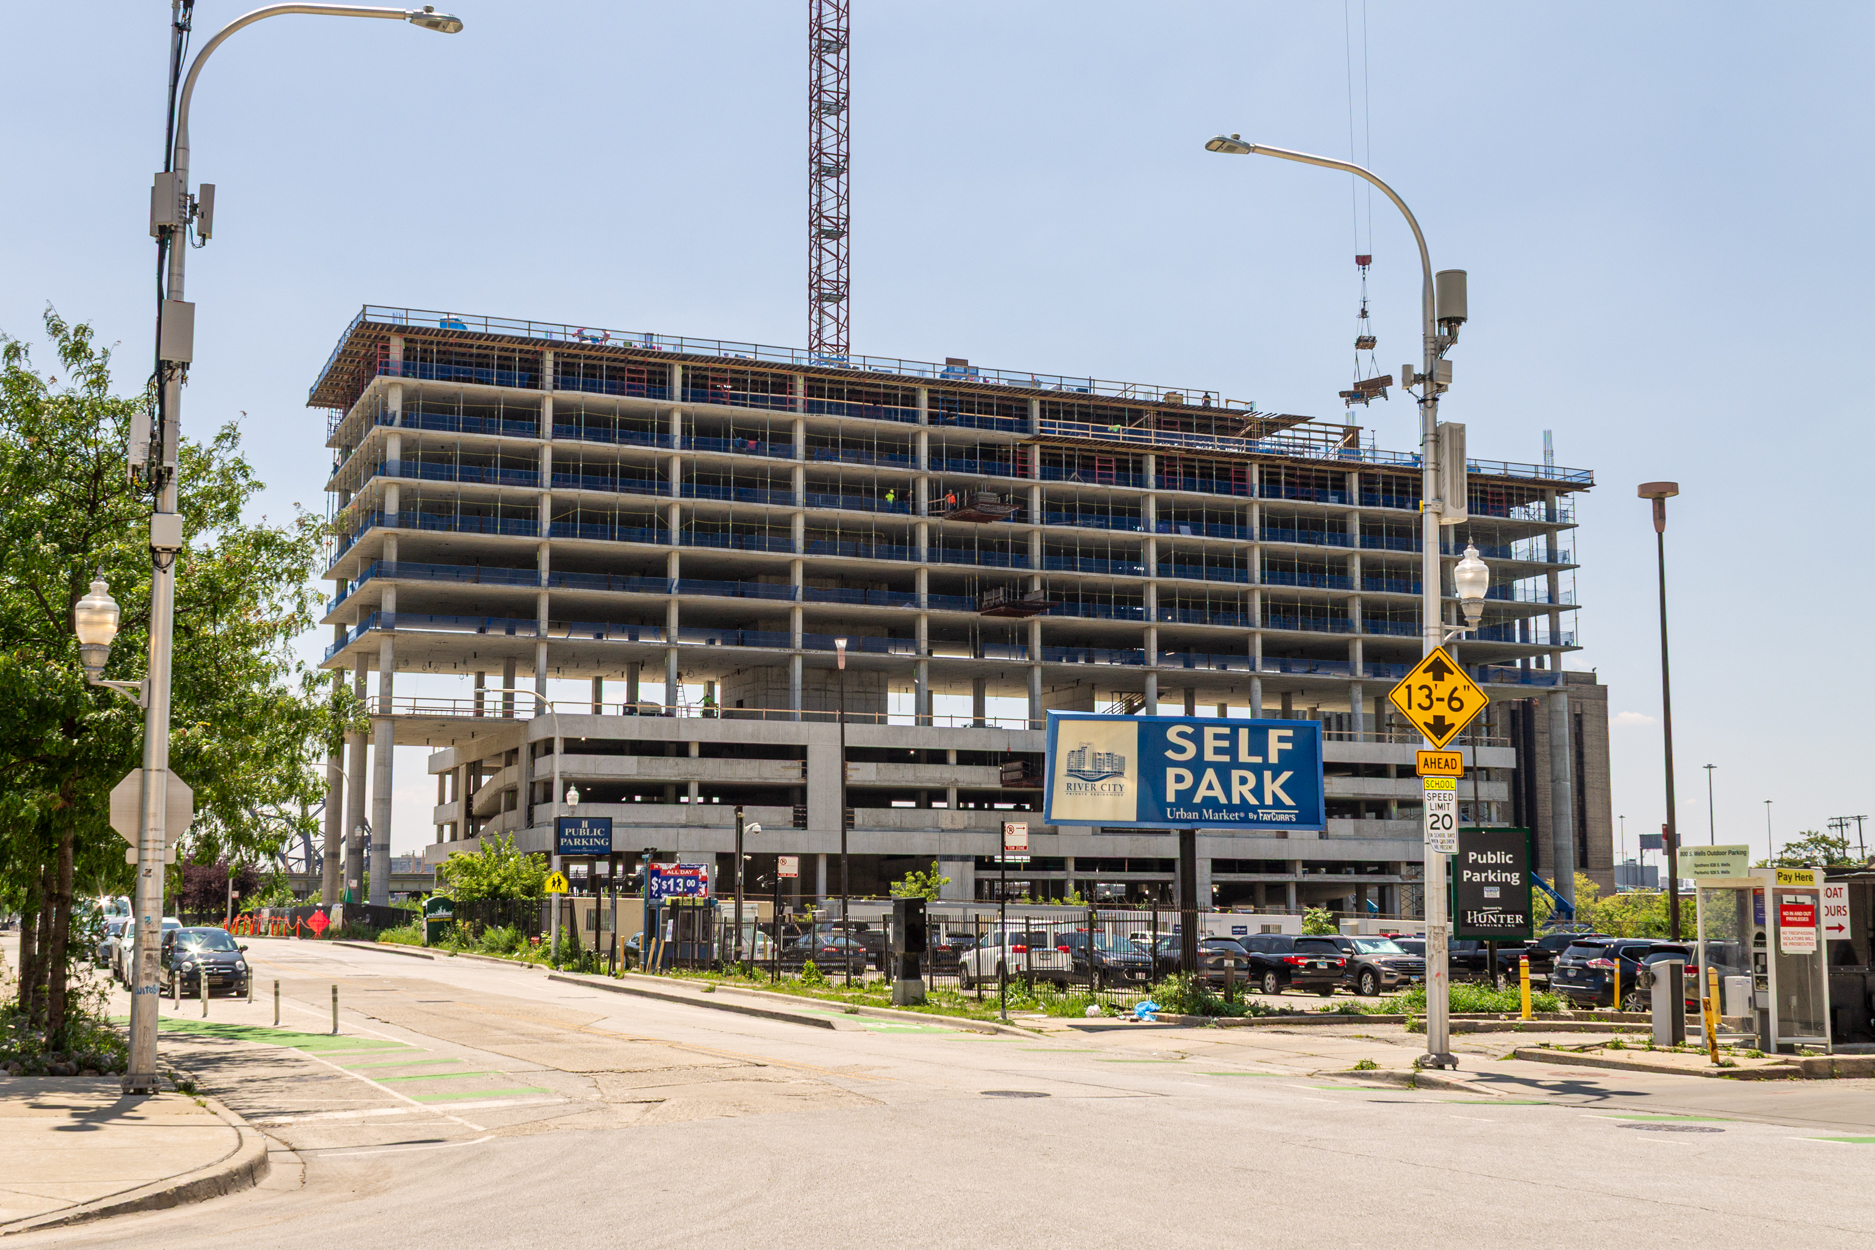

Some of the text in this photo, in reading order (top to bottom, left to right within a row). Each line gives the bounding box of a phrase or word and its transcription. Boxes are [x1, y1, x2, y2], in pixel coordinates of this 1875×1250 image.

[1405, 683, 1470, 713] 13'-6"
[1164, 724, 1294, 764] SELF
[1423, 757, 1458, 770] AHEAD
[1066, 782, 1125, 792] RIVER CITY
[1166, 767, 1296, 806] PARK
[1425, 779, 1455, 789] SCHOOL
[1426, 792, 1454, 802] SPEED
[1429, 802, 1451, 811] LIMIT
[1166, 807, 1199, 820] Urban
[1248, 812, 1258, 821] By
[1429, 813, 1453, 830] 20
[565, 828, 605, 836] PUBLIC
[560, 838, 609, 846] PARKING
[1468, 851, 1513, 863] Public
[1728, 849, 1747, 857] Parking
[1462, 869, 1521, 886] Parking
[1777, 872, 1814, 883] Pay Here
[1823, 887, 1844, 899] OAT
[1466, 910, 1525, 924] HUNTER
